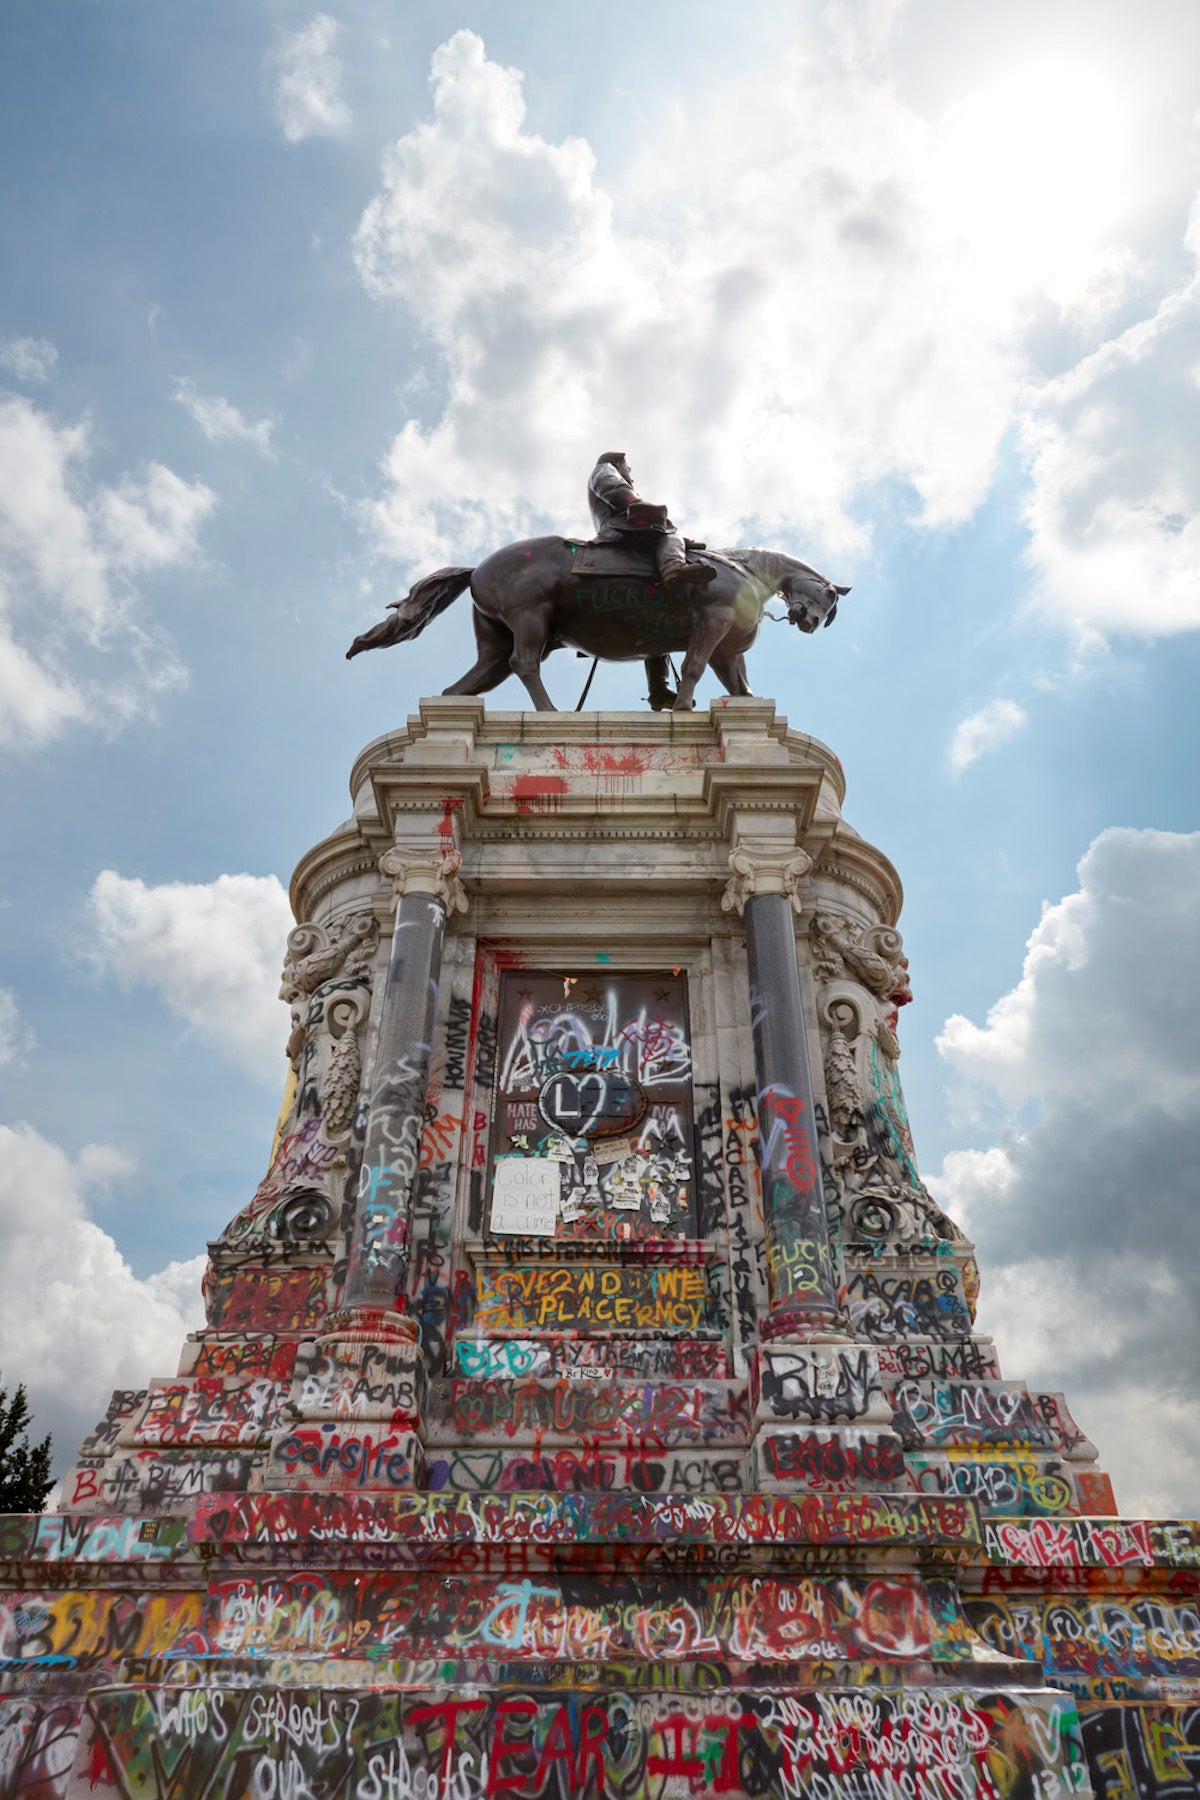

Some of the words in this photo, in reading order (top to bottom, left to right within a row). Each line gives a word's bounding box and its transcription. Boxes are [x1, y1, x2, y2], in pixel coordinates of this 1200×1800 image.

[507, 1103, 538, 1118] HATE
[513, 1117, 538, 1131] HAS
[726, 1129, 748, 1208] ACAB
[768, 1241, 832, 1273] FUCK
[787, 1264, 824, 1296] 12
[537, 1296, 634, 1325] PLACE
[351, 1378, 414, 1409] ACAB
[896, 1383, 1001, 1437] BLM
[272, 1436, 361, 1473] COPS
[670, 1459, 744, 1492] ACAB
[981, 1611, 1042, 1645] COPS
[1051, 1615, 1122, 1648] SUCK
[405, 1699, 610, 1799] TEAR
[1031, 1761, 1088, 1800] 1312
